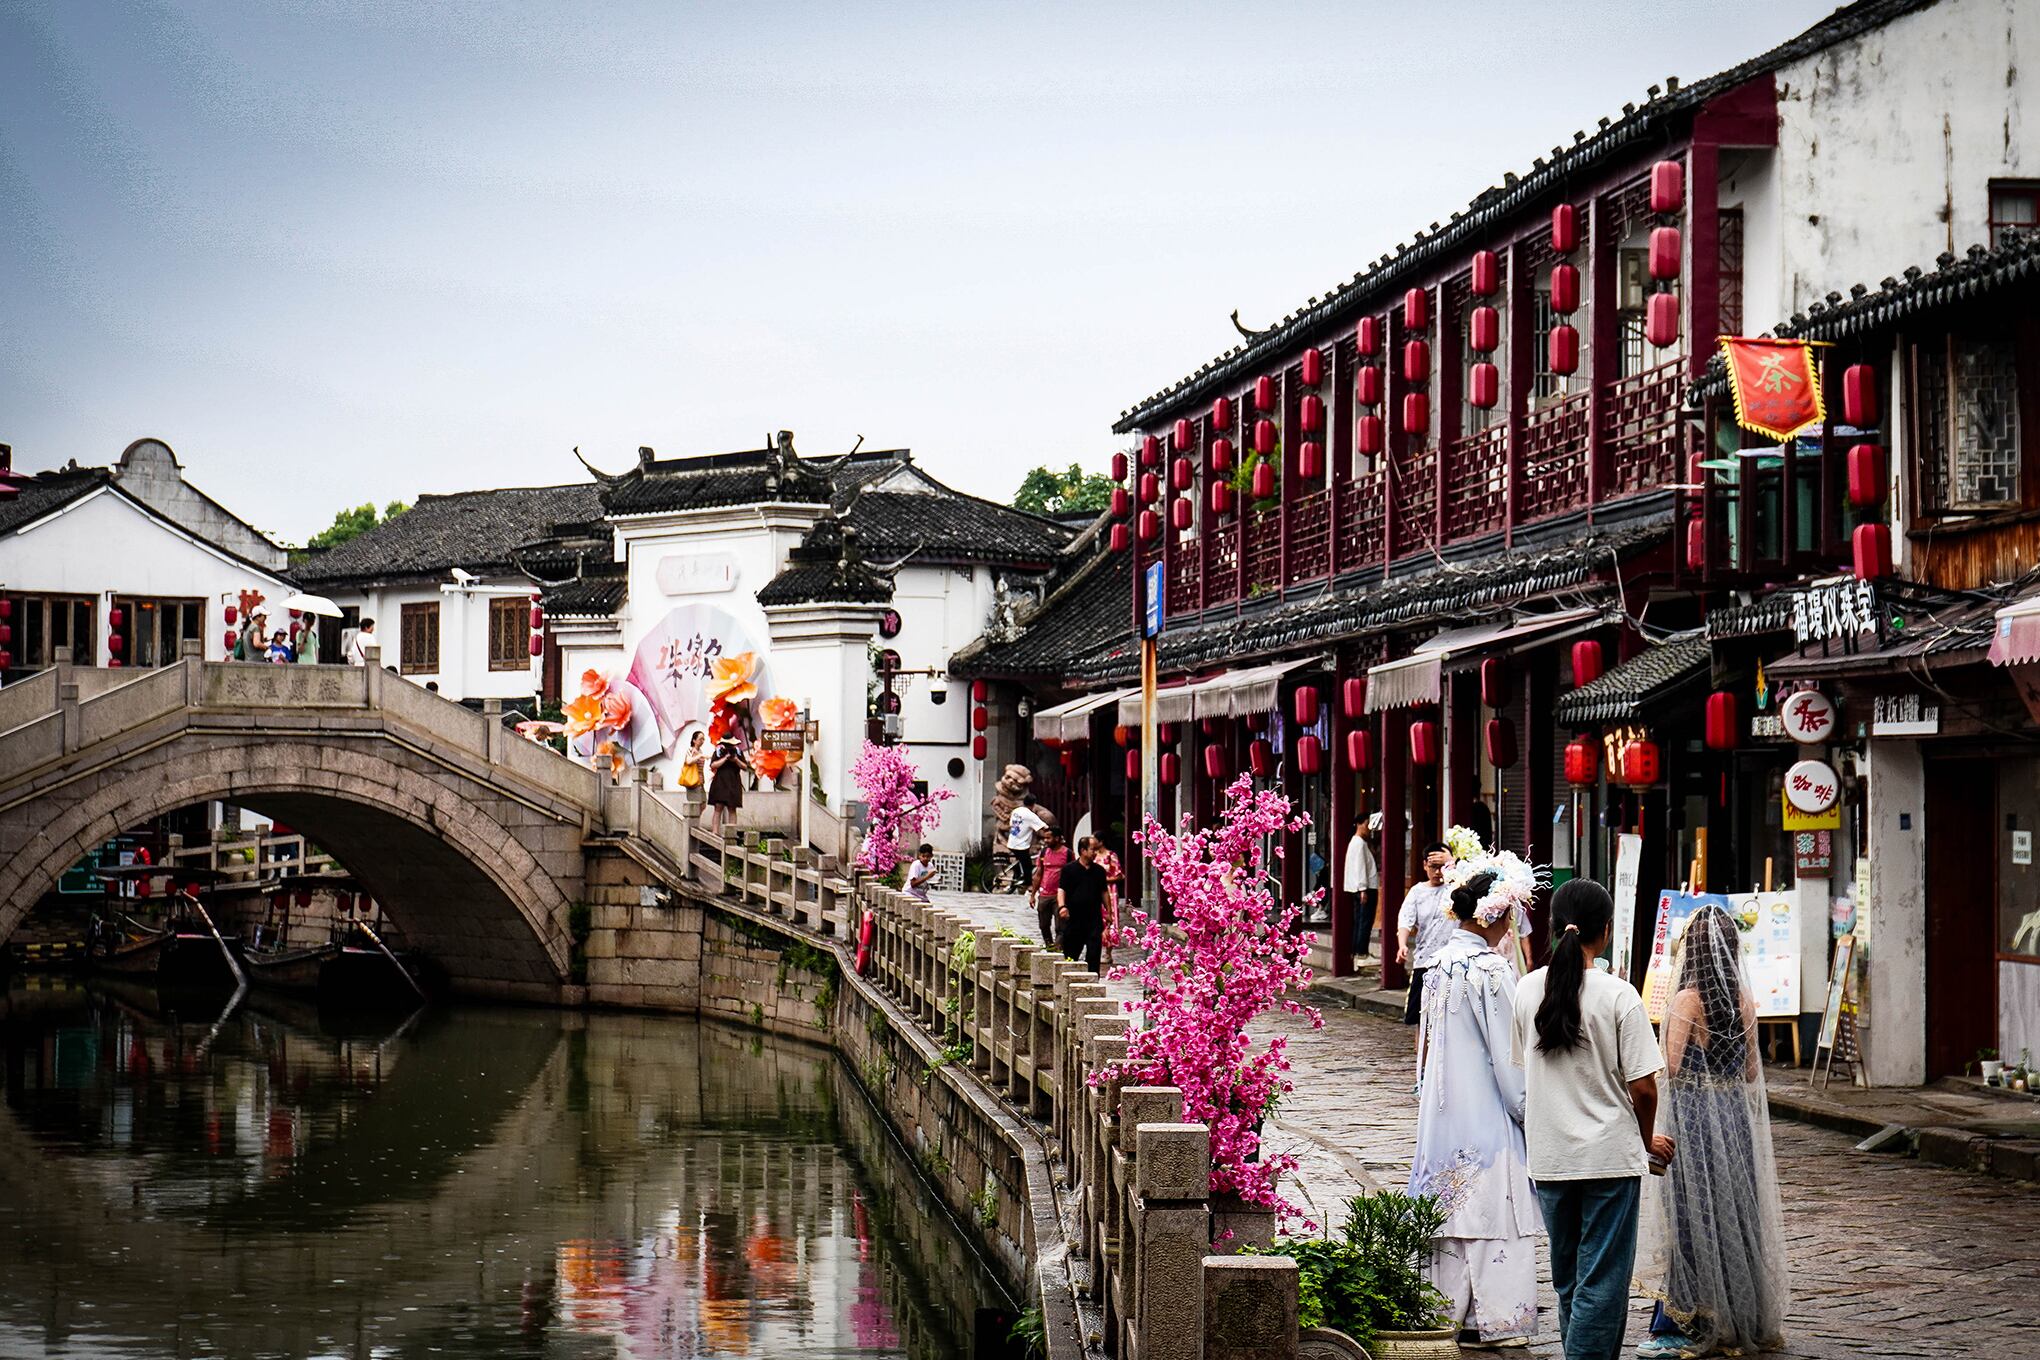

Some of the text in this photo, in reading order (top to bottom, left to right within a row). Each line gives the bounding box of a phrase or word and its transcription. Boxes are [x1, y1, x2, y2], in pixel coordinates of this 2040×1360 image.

[1753, 351, 1803, 394] 茶
[1792, 578, 1877, 643] 福璟仪珠宝
[1792, 774, 1834, 805] 咖啡
[1797, 833, 1815, 854] 茶
